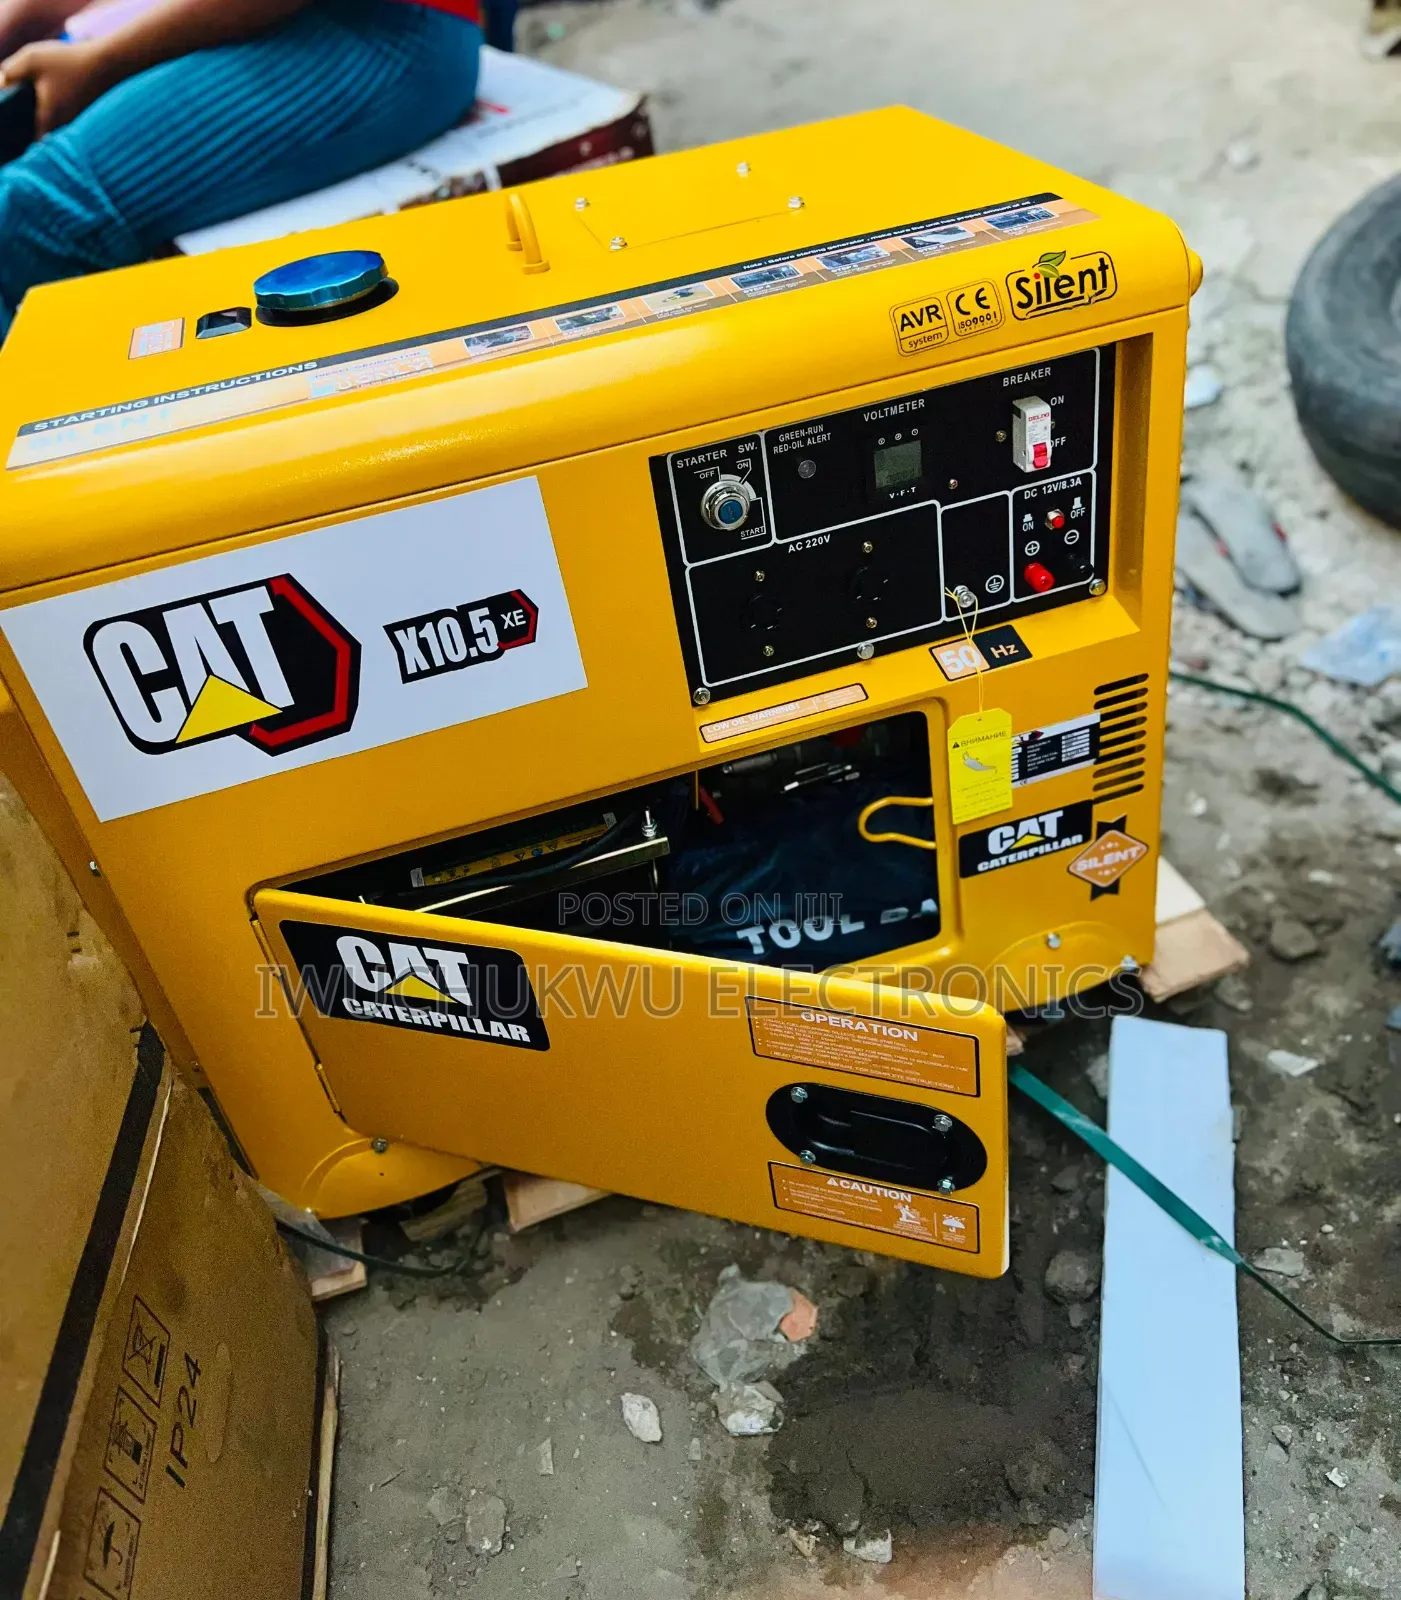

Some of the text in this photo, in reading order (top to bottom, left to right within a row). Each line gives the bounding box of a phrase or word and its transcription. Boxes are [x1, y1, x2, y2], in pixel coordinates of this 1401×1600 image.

[827, 238, 864, 250] generator
[1015, 257, 1110, 310] Silent
[900, 304, 942, 332] AVR
[908, 331, 943, 349] system
[1003, 367, 1051, 387] BREAKER
[33, 400, 150, 431] STARTING
[155, 361, 318, 404] INSTRUCTIONS
[1051, 395, 1065, 406] ON
[863, 398, 925, 422] VOLTMETER
[773, 432, 832, 454] RED-OIL ALERT
[778, 424, 824, 443] GREEN-RUN
[676, 442, 758, 469] STARTER SW.
[737, 461, 749, 470] ON
[699, 470, 715, 479] OFF
[1024, 477, 1082, 499] DC 12V/8.3A
[1070, 507, 1086, 519] OFF
[740, 526, 765, 538] START
[1022, 521, 1034, 532] ON
[788, 534, 831, 553] AC 220V
[394, 607, 527, 675] X10.5 XE
[92, 585, 295, 744] CAT
[940, 643, 1019, 673] 50 Hz
[706, 720, 730, 734] LOW
[732, 715, 747, 727] OIL
[748, 702, 800, 722] WARNING!
[961, 731, 1007, 747] ВНИМАНИЕ
[988, 810, 1064, 855] CAT
[977, 834, 1083, 872] CATERPILLAR
[1077, 846, 1141, 872] SILENT
[336, 936, 473, 1006] CAT
[341, 997, 531, 1043] CATERPILLAR
[800, 1011, 918, 1042] OPERATION
[839, 1178, 912, 1202] CAUTION
